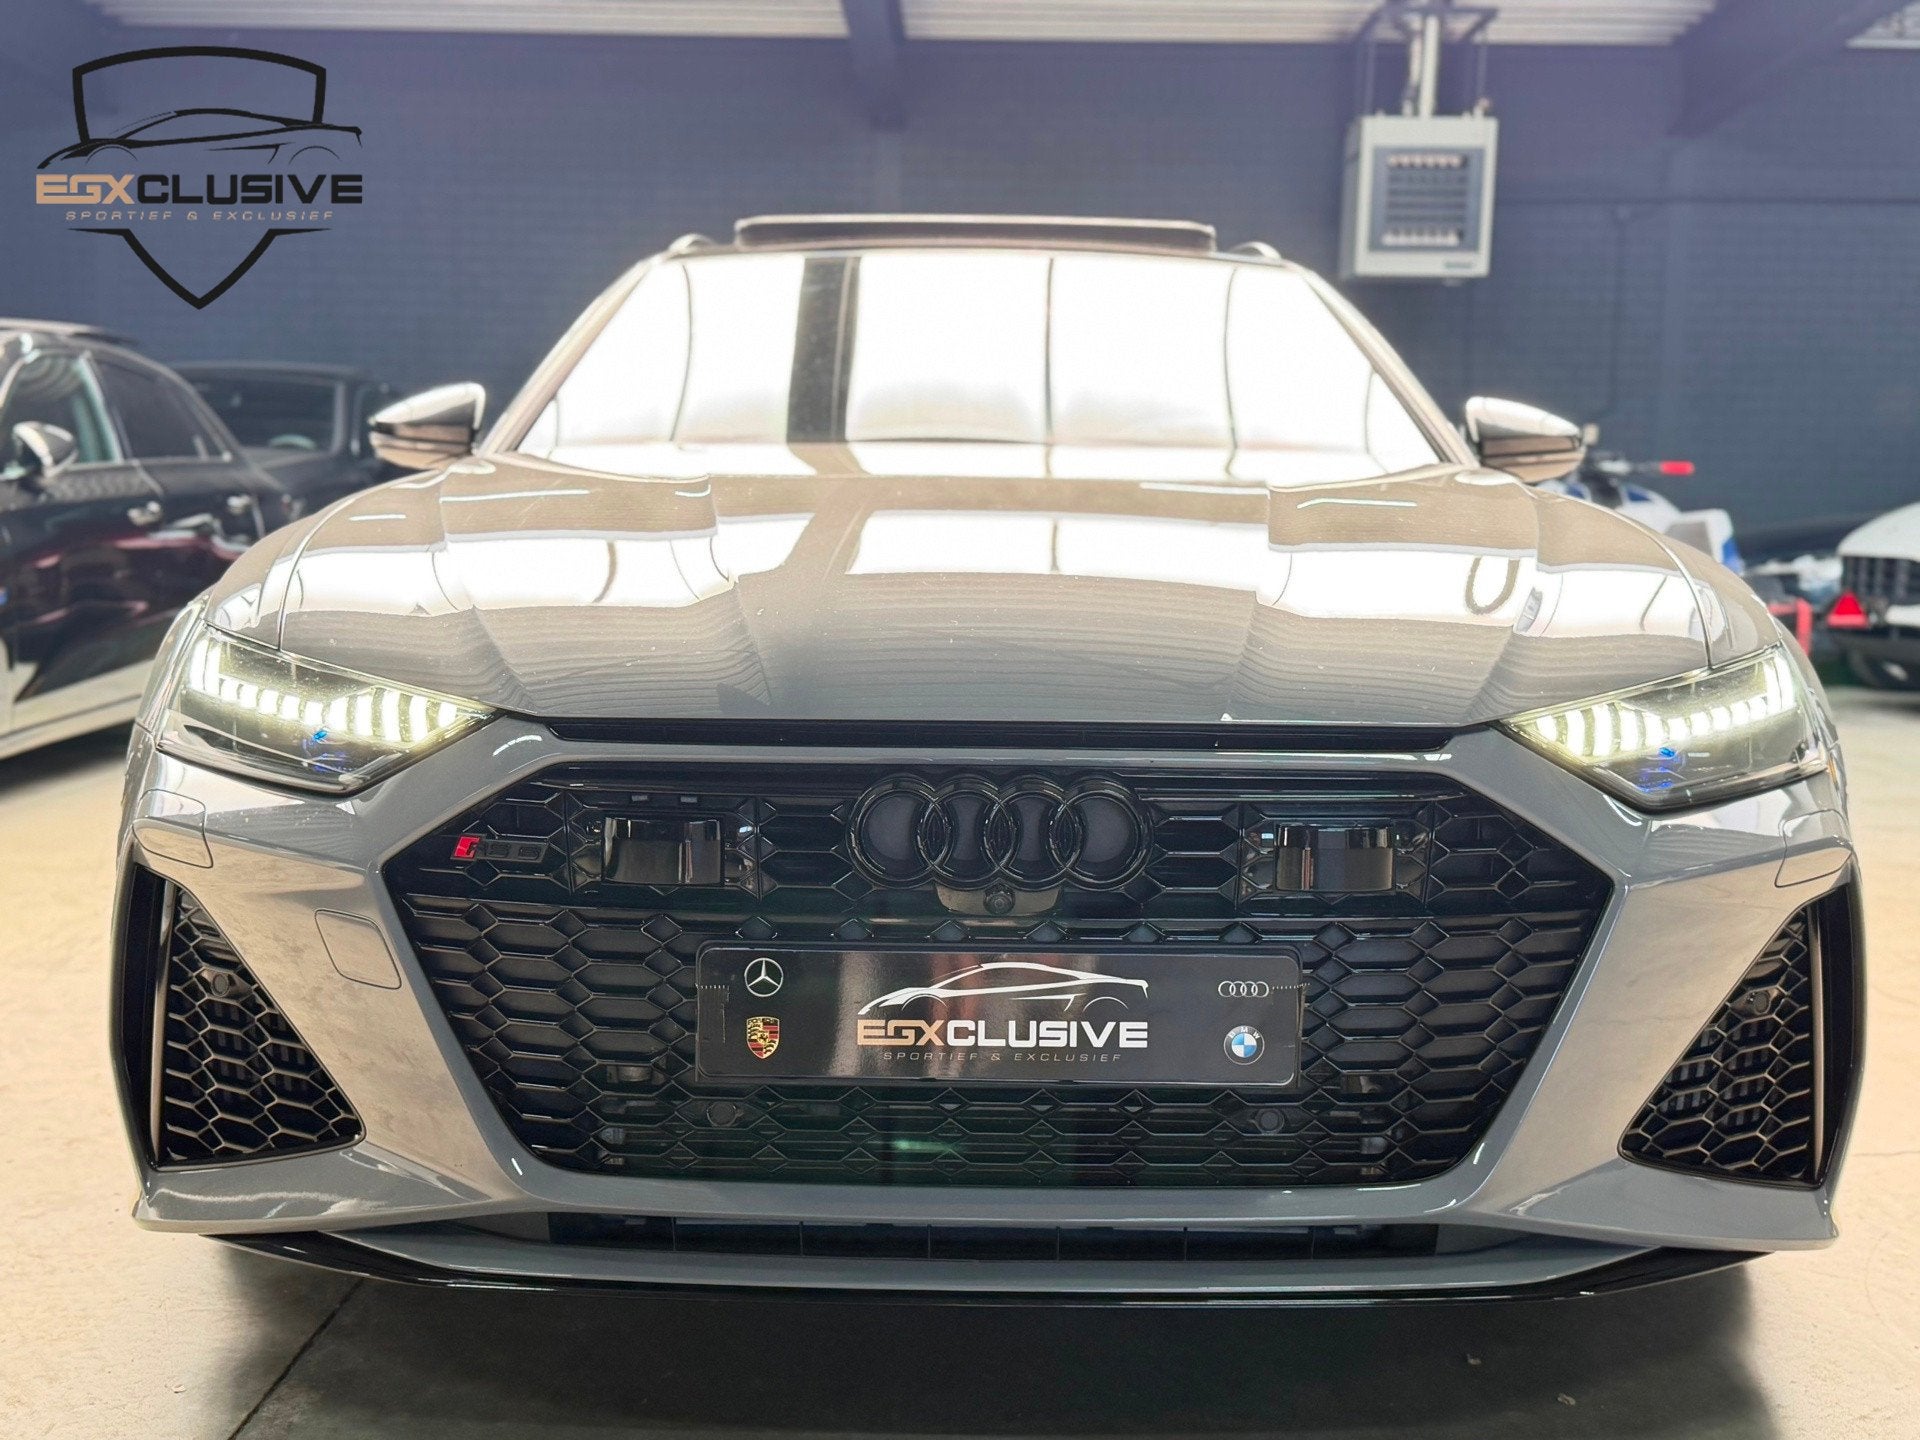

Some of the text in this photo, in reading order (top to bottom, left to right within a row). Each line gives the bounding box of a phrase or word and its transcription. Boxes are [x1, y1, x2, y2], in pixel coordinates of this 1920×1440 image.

[857, 1019, 1148, 1048] EGXCLUSIVE
[1227, 1026, 1261, 1039] BMW
[883, 1051, 1122, 1063] SPORTIEF & EXCLUSIEF
